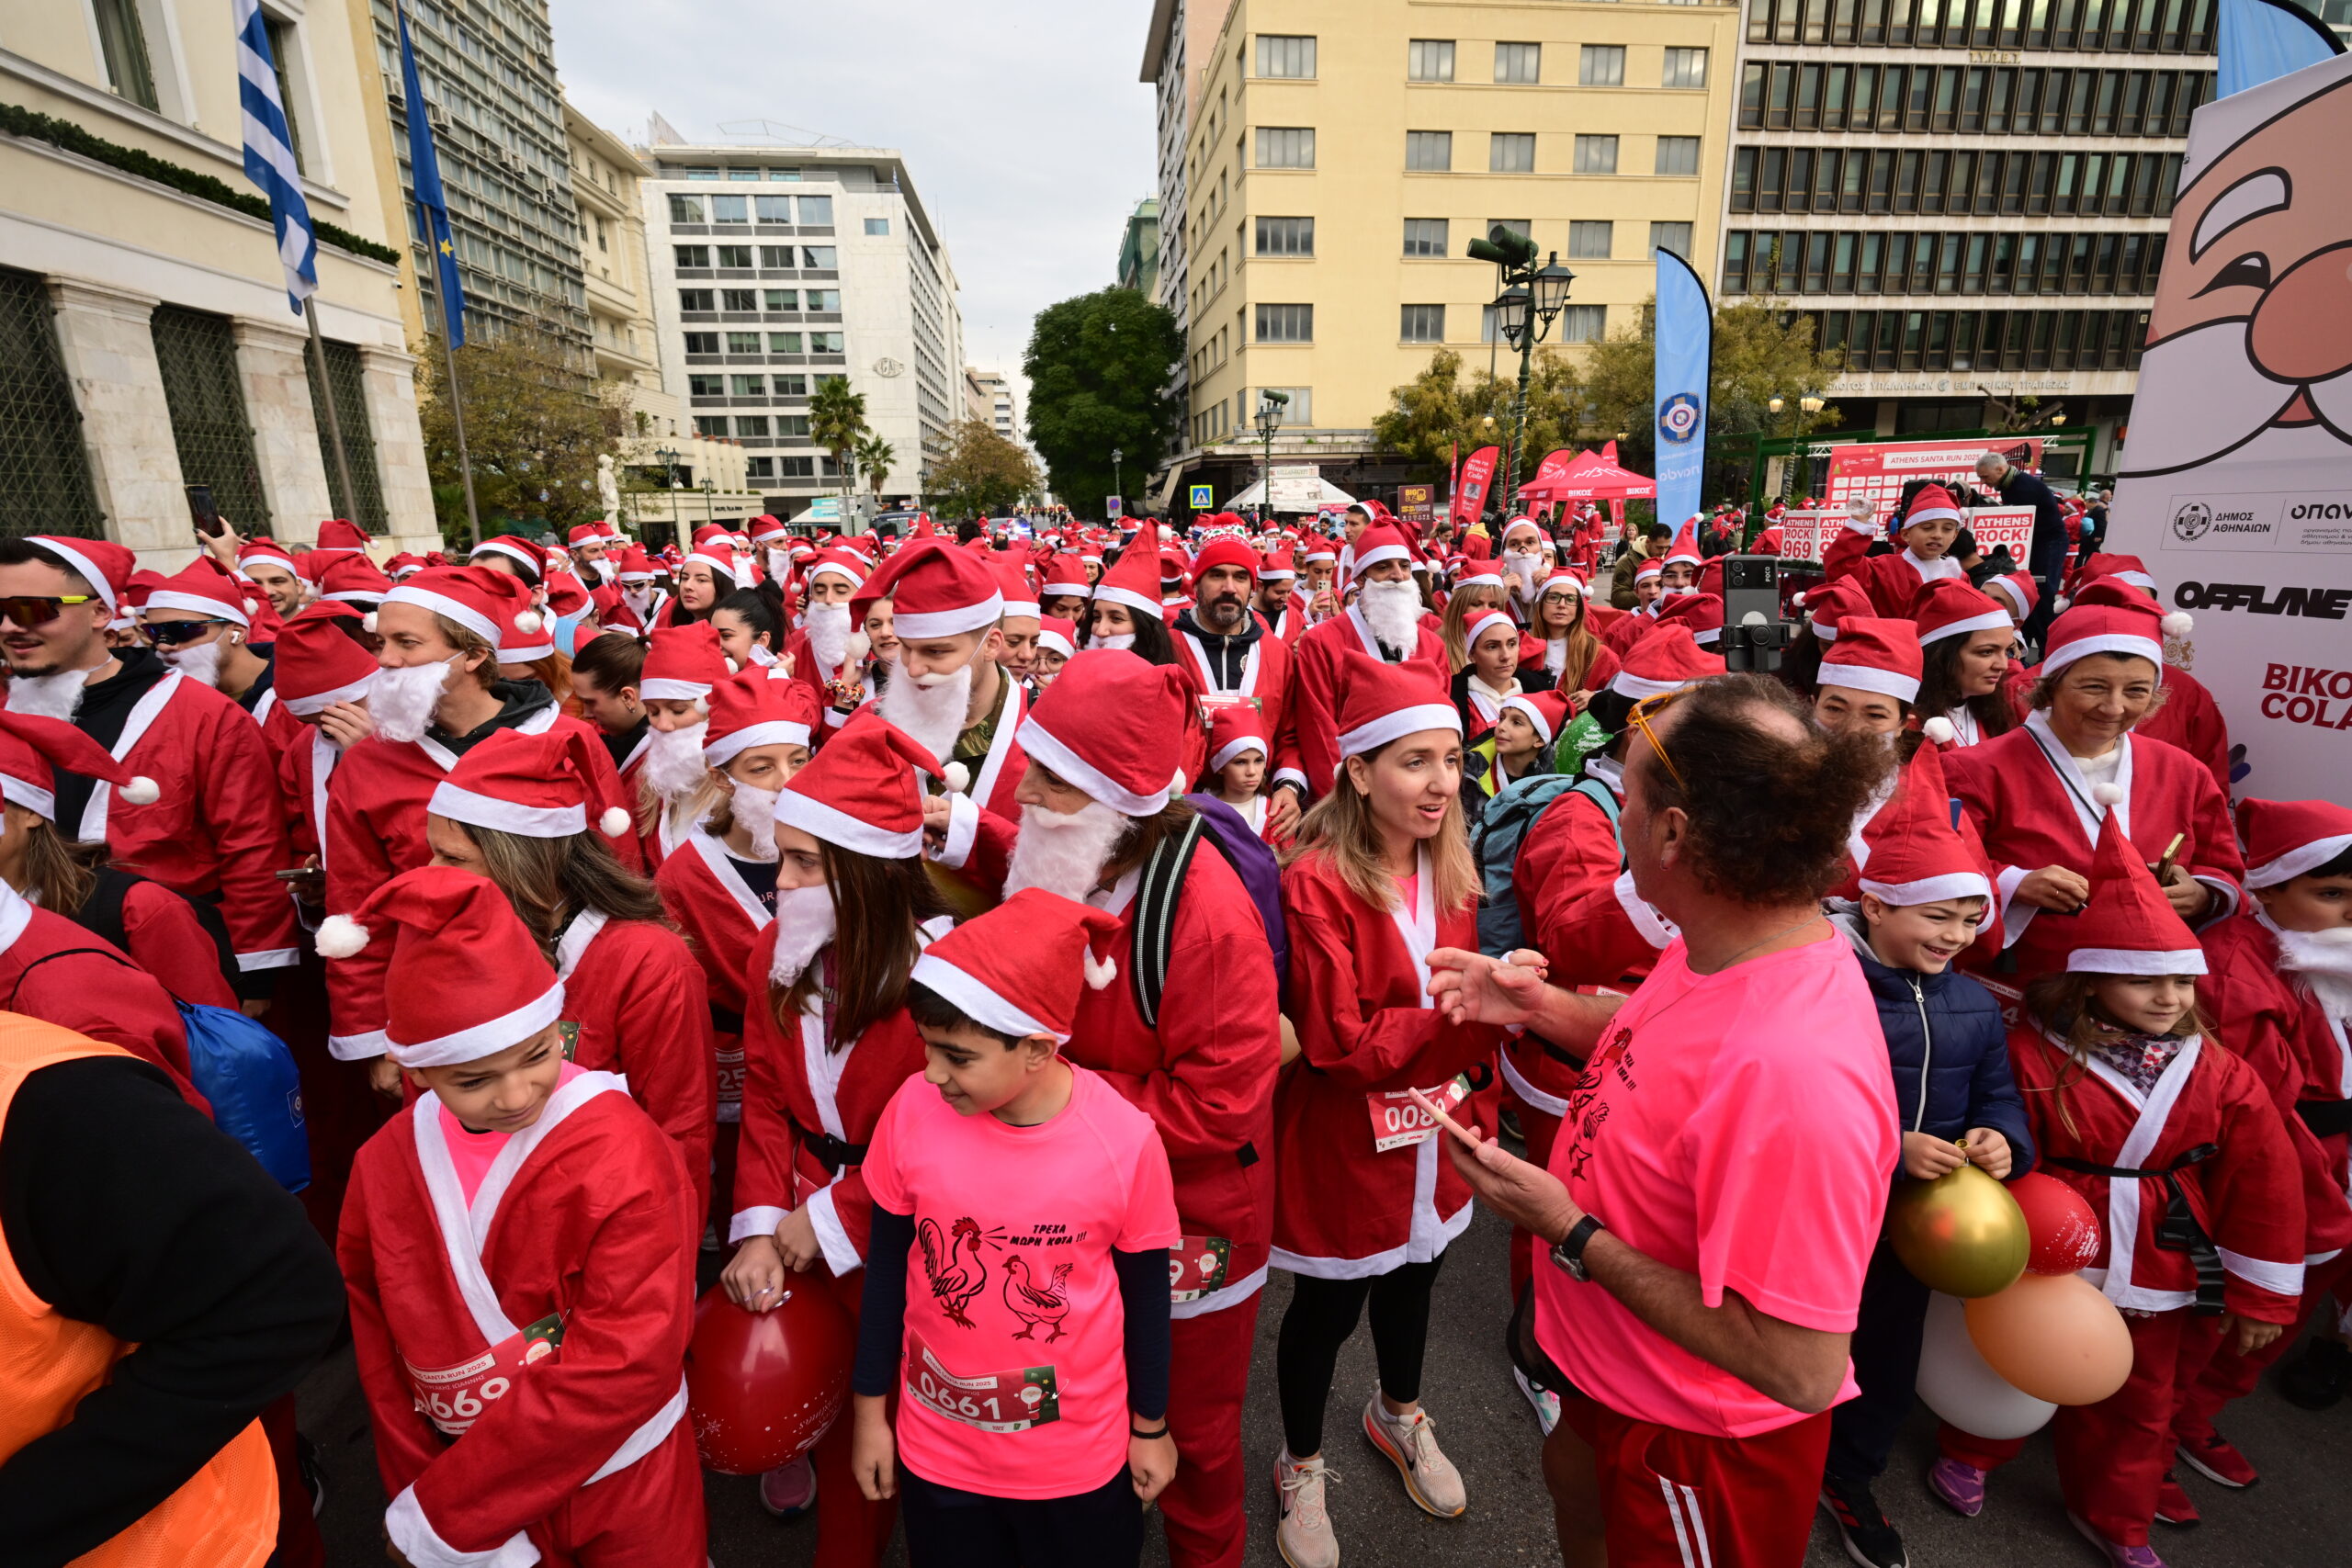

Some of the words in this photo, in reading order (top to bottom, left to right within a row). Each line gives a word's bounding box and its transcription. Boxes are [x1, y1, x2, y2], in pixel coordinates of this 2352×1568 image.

[1891, 456, 1919, 464] ATHENS
[1921, 455, 1943, 463] SANTA
[1626, 487, 1650, 495] ΒΙΚΟΣ
[1976, 516, 2030, 527] ATHENS
[2215, 513, 2255, 521] ΔΗΜΟΣ
[1786, 519, 1815, 527] ATHENS
[1822, 519, 1845, 527] ATH
[2212, 524, 2271, 533] ΑΘΗΝΑΙΩΝ
[1785, 529, 1814, 539] ROCK!
[1975, 529, 2029, 542] ROCK!
[1783, 540, 1812, 558] 969
[1976, 543, 2026, 564] 99
[1033, 1224, 1067, 1235] ΤΡΕΧΑ
[1010, 1235, 1043, 1247] ΜΩΡΗ
[1046, 1235, 1073, 1247] ΚΟΤΑ
[1076, 1231, 1087, 1242] !!!
[423, 1372, 447, 1382] SANTA
[447, 1370, 467, 1379] RUN
[467, 1360, 487, 1373] 2025
[925, 1355, 942, 1373] ATHENS
[942, 1369, 959, 1385] SANTA
[921, 1371, 1001, 1420] 0661
